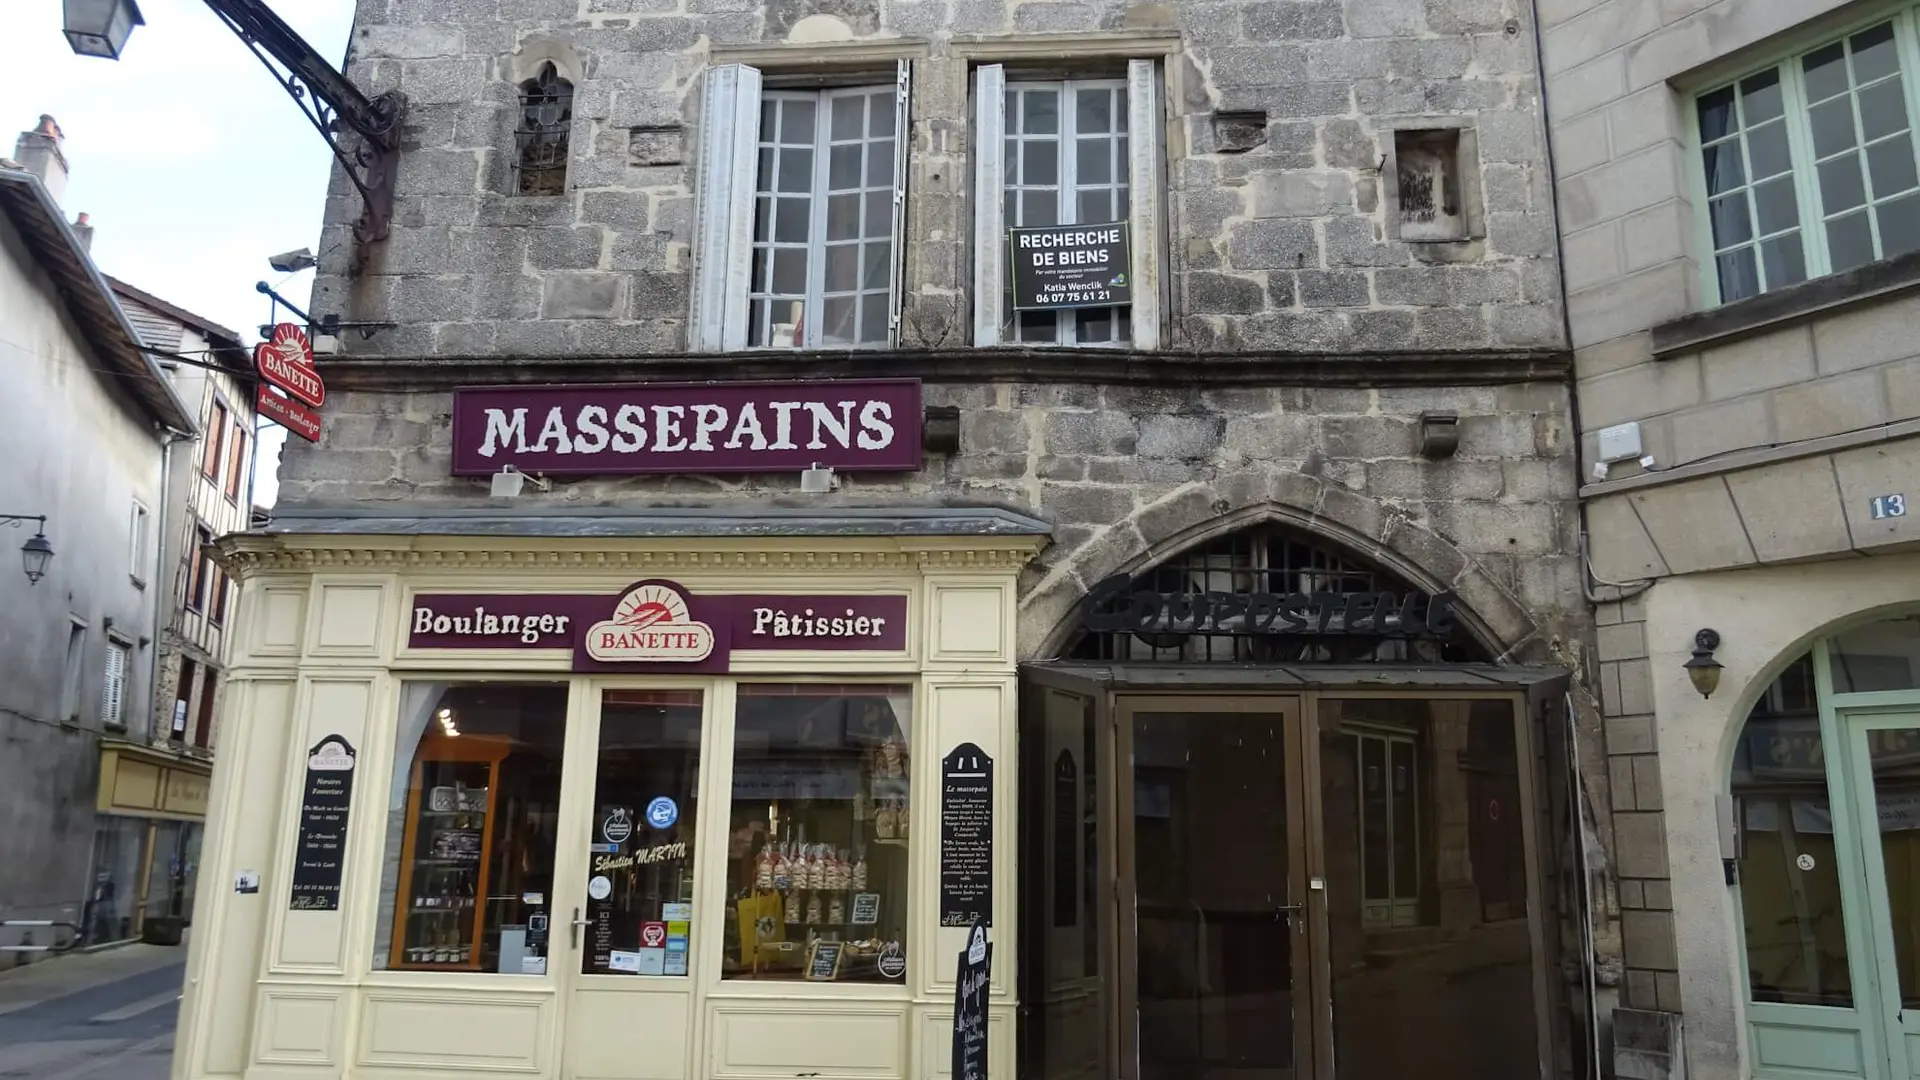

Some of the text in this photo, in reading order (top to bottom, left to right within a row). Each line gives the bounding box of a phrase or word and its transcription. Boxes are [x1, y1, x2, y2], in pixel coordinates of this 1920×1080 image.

[1020, 229, 1120, 248] RECHERCHE
[1033, 249, 1109, 266] DE BIENS
[1036, 290, 1110, 303] 06 07 75 61 21
[1044, 280, 1103, 292] Katia Wenclik
[265, 352, 320, 397] BANETTE
[478, 400, 895, 457] MASSEPAINS
[1873, 494, 1905, 519] 13
[414, 606, 570, 643] Boulanger
[752, 607, 886, 639] Pâtissier
[600, 631, 700, 649] BANETTE
[636, 842, 686, 865] MARTIN
